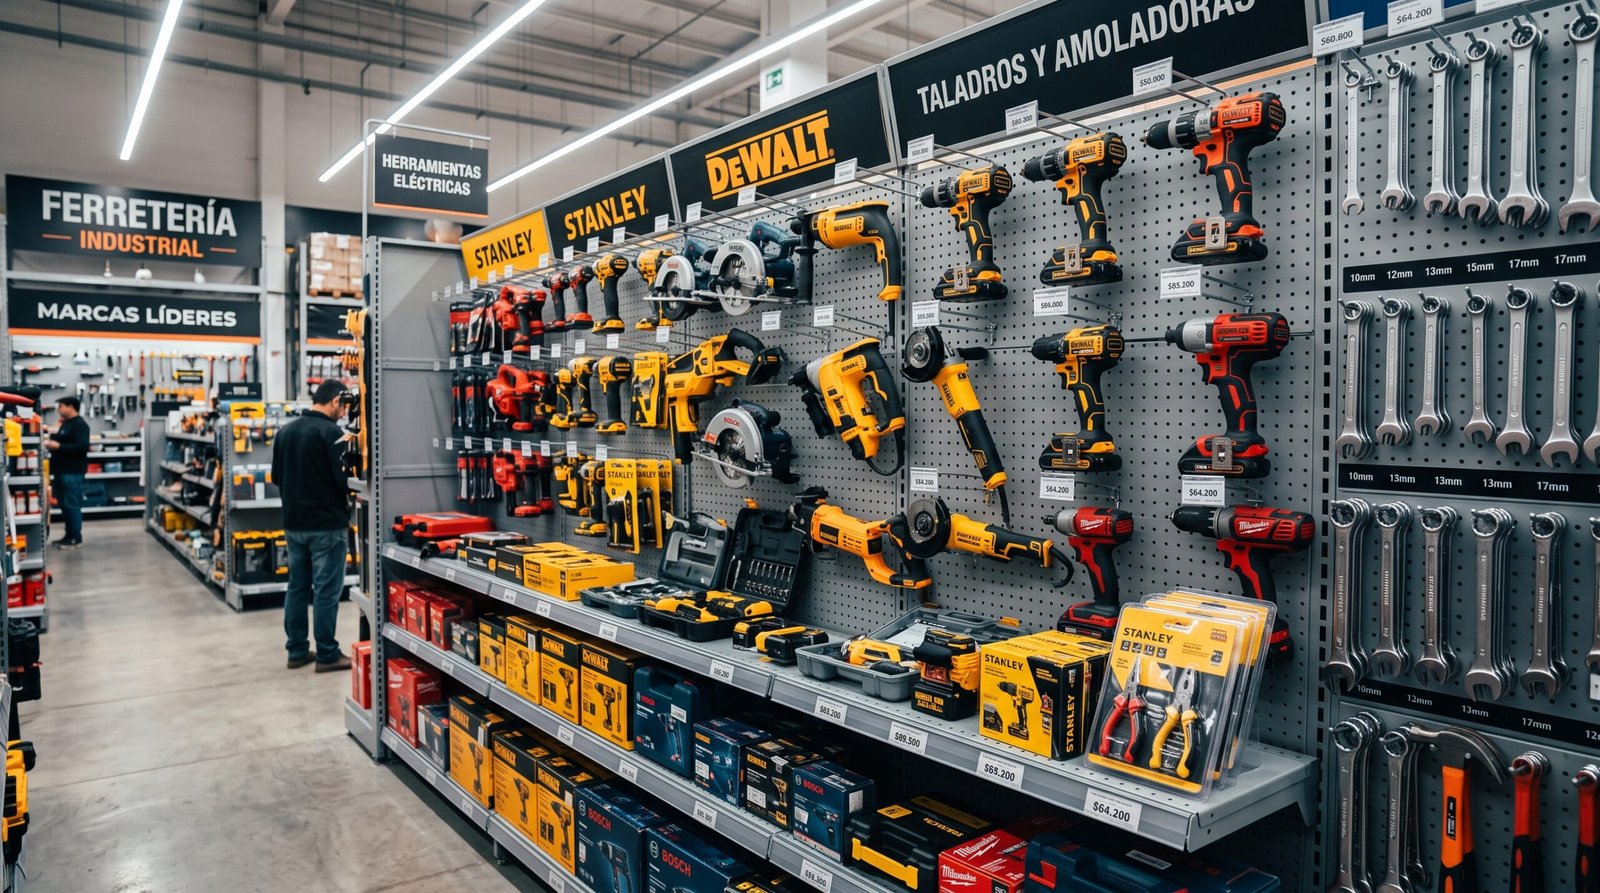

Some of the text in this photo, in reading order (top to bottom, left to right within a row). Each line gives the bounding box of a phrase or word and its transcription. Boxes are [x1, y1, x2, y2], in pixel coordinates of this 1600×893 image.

[1396, 6, 1432, 25] $64.200
[1321, 30, 1353, 46] $60.800
[916, 52, 1028, 115] TALADROS
[1029, 45, 1046, 77] Y
[382, 153, 482, 179] HERRAMIENTAS
[393, 173, 471, 197] ELÉCTRICAS
[42, 189, 237, 237] FERRETERÍA
[563, 185, 647, 241] STANLEY
[80, 230, 204, 259] INDUSTRIAL
[474, 229, 533, 269] STANLEY
[1350, 253, 1586, 283] 10mm 12mm 13mm 15mm 17mm 17mm
[37, 302, 238, 328] MARCAS LÍDERES
[607, 471, 634, 480] STANLEY
[1348, 472, 1569, 492] 10mm 13mm 13mm 13mm 17mm
[1189, 488, 1218, 497] $64.200
[1123, 627, 1174, 644] STANLEY
[984, 653, 1023, 672] STANLEY
[1066, 694, 1075, 753] STANLEY
[1356, 684, 1600, 741] 10mm 12mm 13mm 17mm 12
[802, 779, 824, 796] BOSCH
[588, 807, 611, 832] BOSCH
[1092, 801, 1131, 823] $64.200
[661, 849, 692, 878] BOSCH
